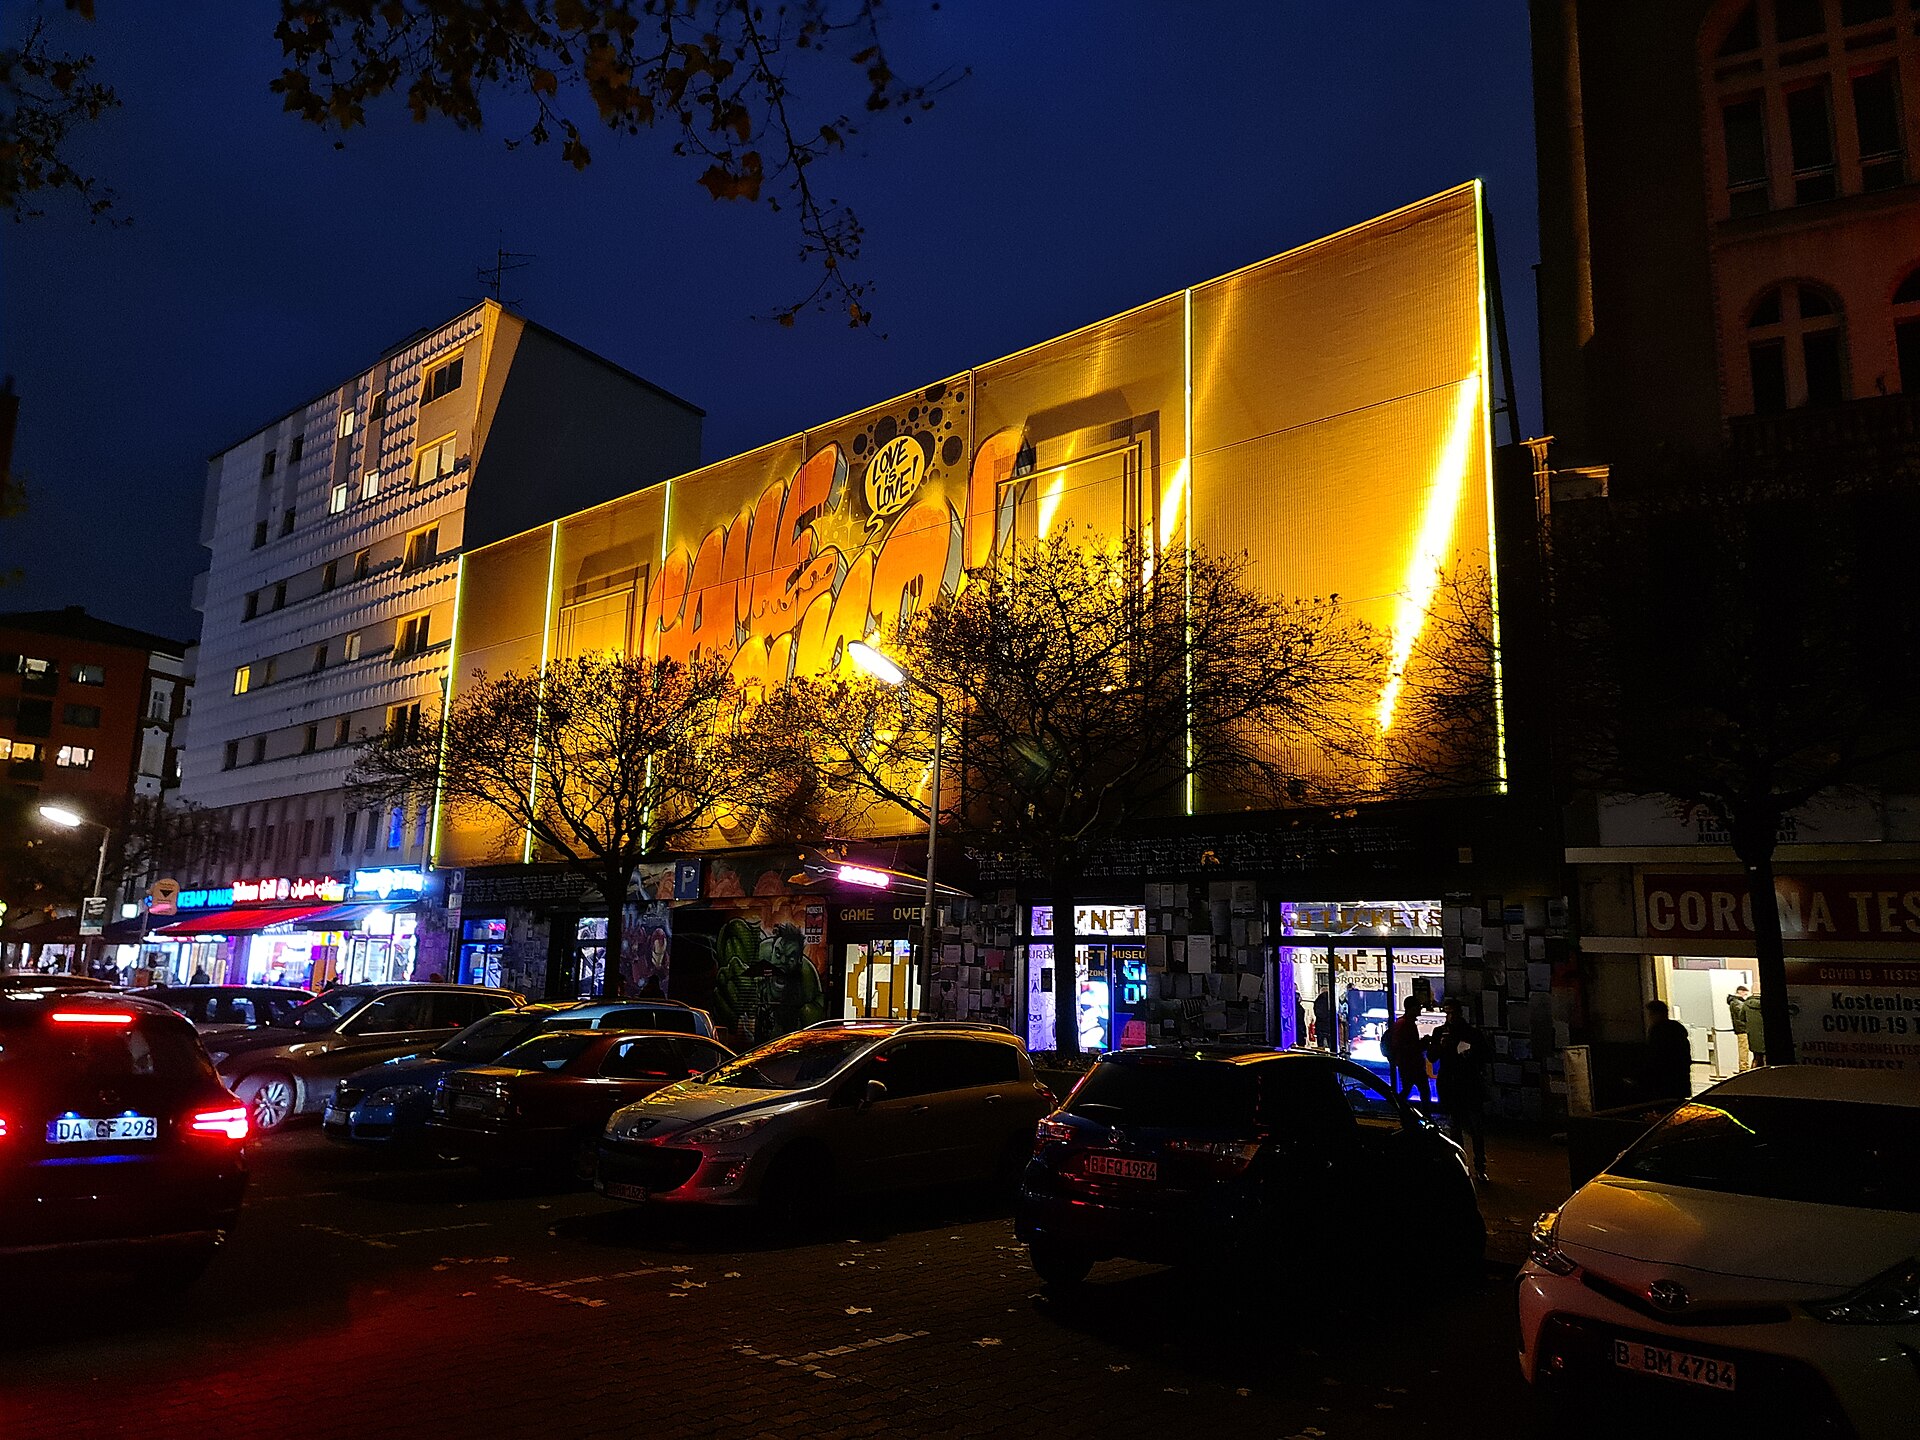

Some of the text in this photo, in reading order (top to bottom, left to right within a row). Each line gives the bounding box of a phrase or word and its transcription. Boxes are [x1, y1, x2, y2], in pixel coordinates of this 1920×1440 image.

[873, 438, 909, 486] LOVE
[876, 455, 919, 511] LOVE!
[681, 866, 696, 893] P
[839, 908, 876, 921] GAME
[1091, 908, 1144, 931] NFT
[1335, 954, 1387, 971] NFT
[1823, 1014, 1907, 1035] COVID-19
[59, 1123, 83, 1140] DA
[121, 1119, 155, 1138] 298
[1124, 1160, 1156, 1180] 1984
[1616, 1341, 1630, 1365] B
[1677, 1354, 1735, 1386] 4784
